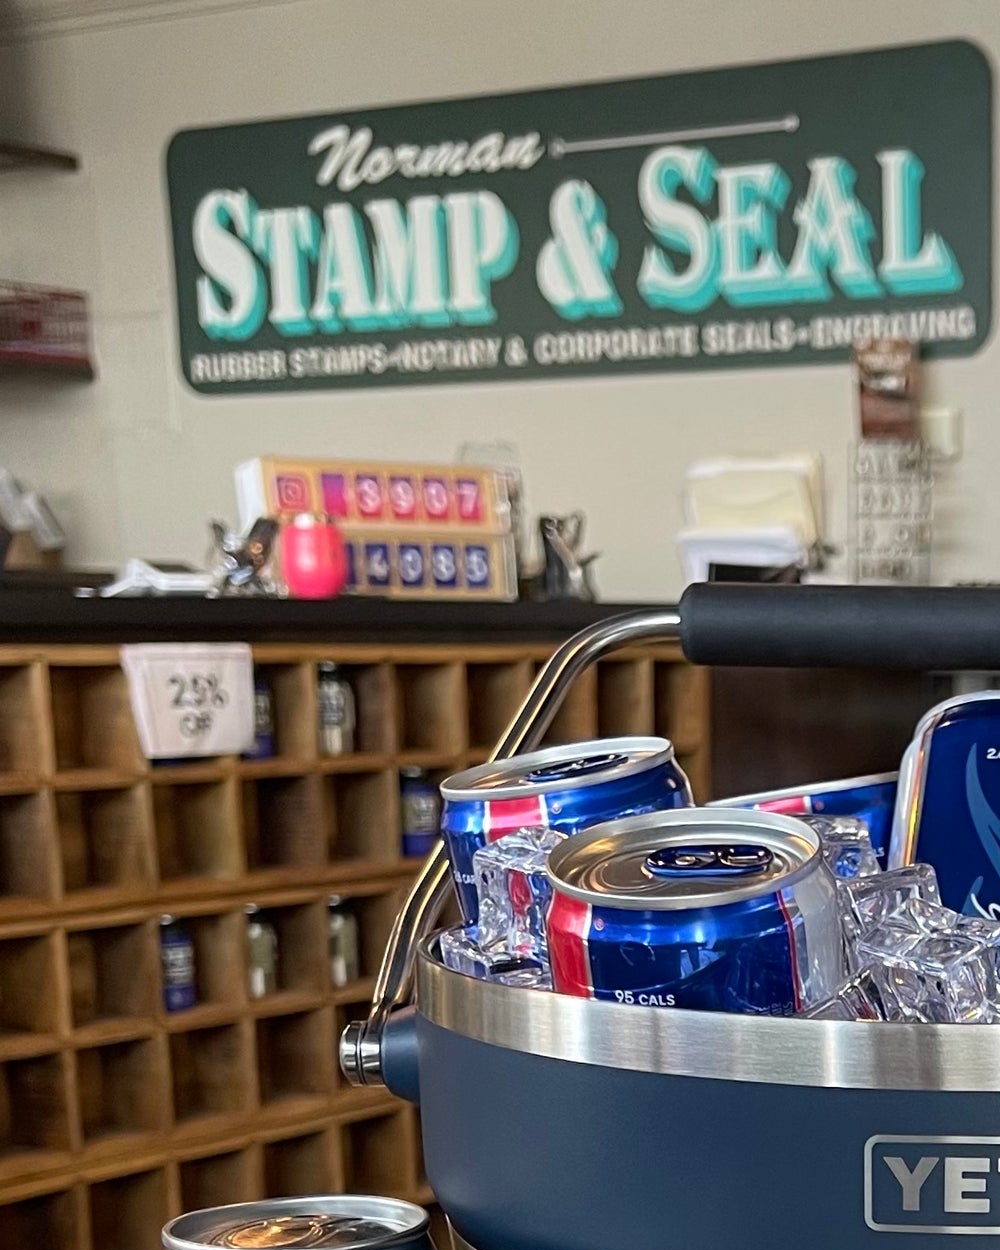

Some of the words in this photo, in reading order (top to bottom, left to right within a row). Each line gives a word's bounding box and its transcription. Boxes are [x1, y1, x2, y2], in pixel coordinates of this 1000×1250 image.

[307, 124, 545, 192] Norman
[192, 188, 520, 341] STAMP
[535, 178, 624, 320] &
[637, 145, 964, 314] SEAL
[191, 350, 287, 383] RUBBER
[505, 334, 528, 367] &
[533, 327, 698, 365] CORPORATE
[614, 989, 635, 1004] 95
[638, 994, 676, 1006] CALS
